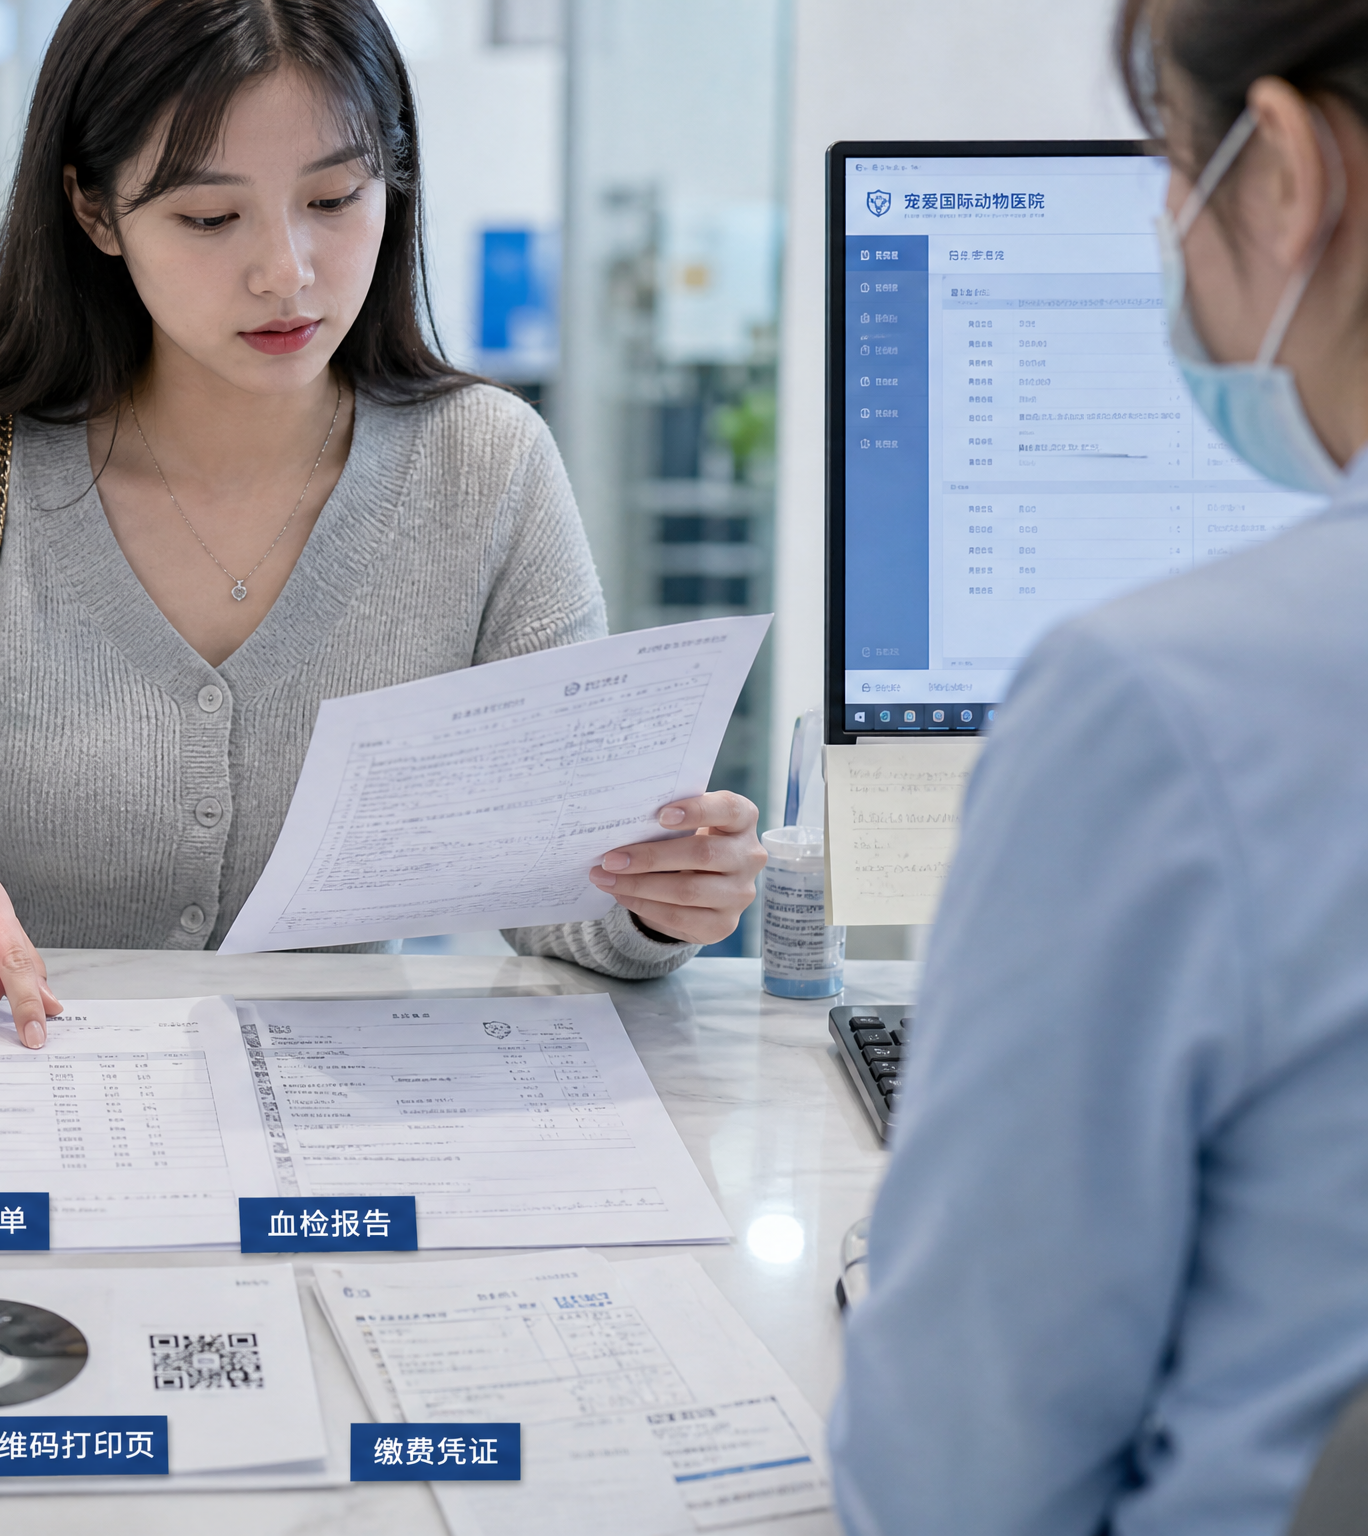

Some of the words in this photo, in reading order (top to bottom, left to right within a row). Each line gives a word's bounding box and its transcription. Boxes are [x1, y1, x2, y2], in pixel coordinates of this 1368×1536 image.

[904, 192, 1045, 210] 宠爱国际动物医院
[267, 1208, 391, 1238] 血检报告
[374, 1436, 498, 1466] 缴费凭证
